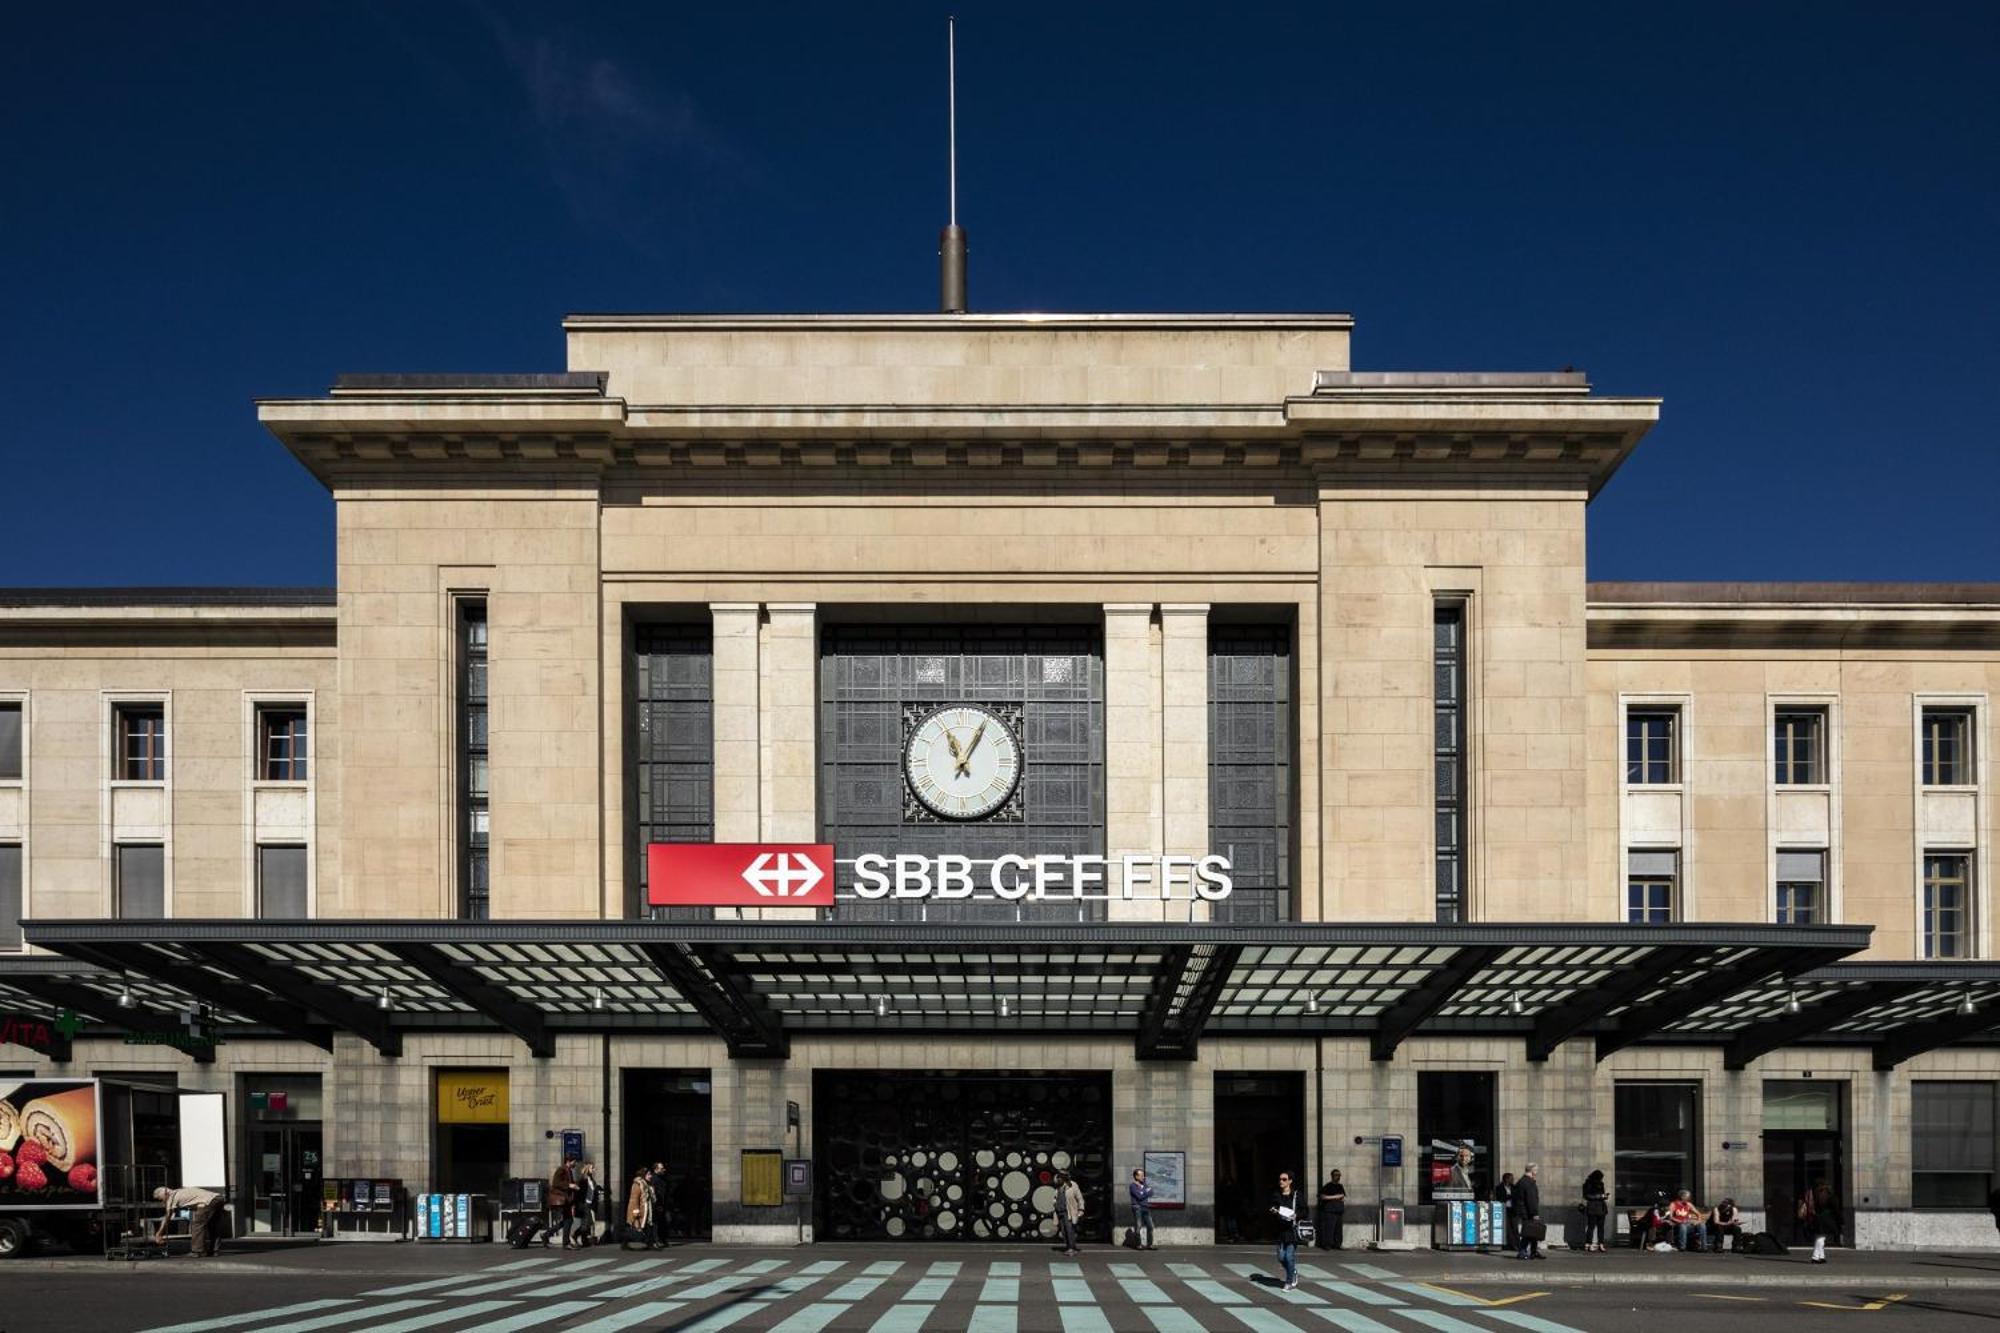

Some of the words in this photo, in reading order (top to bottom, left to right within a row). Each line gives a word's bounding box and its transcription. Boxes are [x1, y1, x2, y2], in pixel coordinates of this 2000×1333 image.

[853, 854, 975, 899] SBB
[990, 854, 1103, 900] CFF
[1122, 855, 1233, 900] FFS
[456, 1087, 488, 1102] Upper
